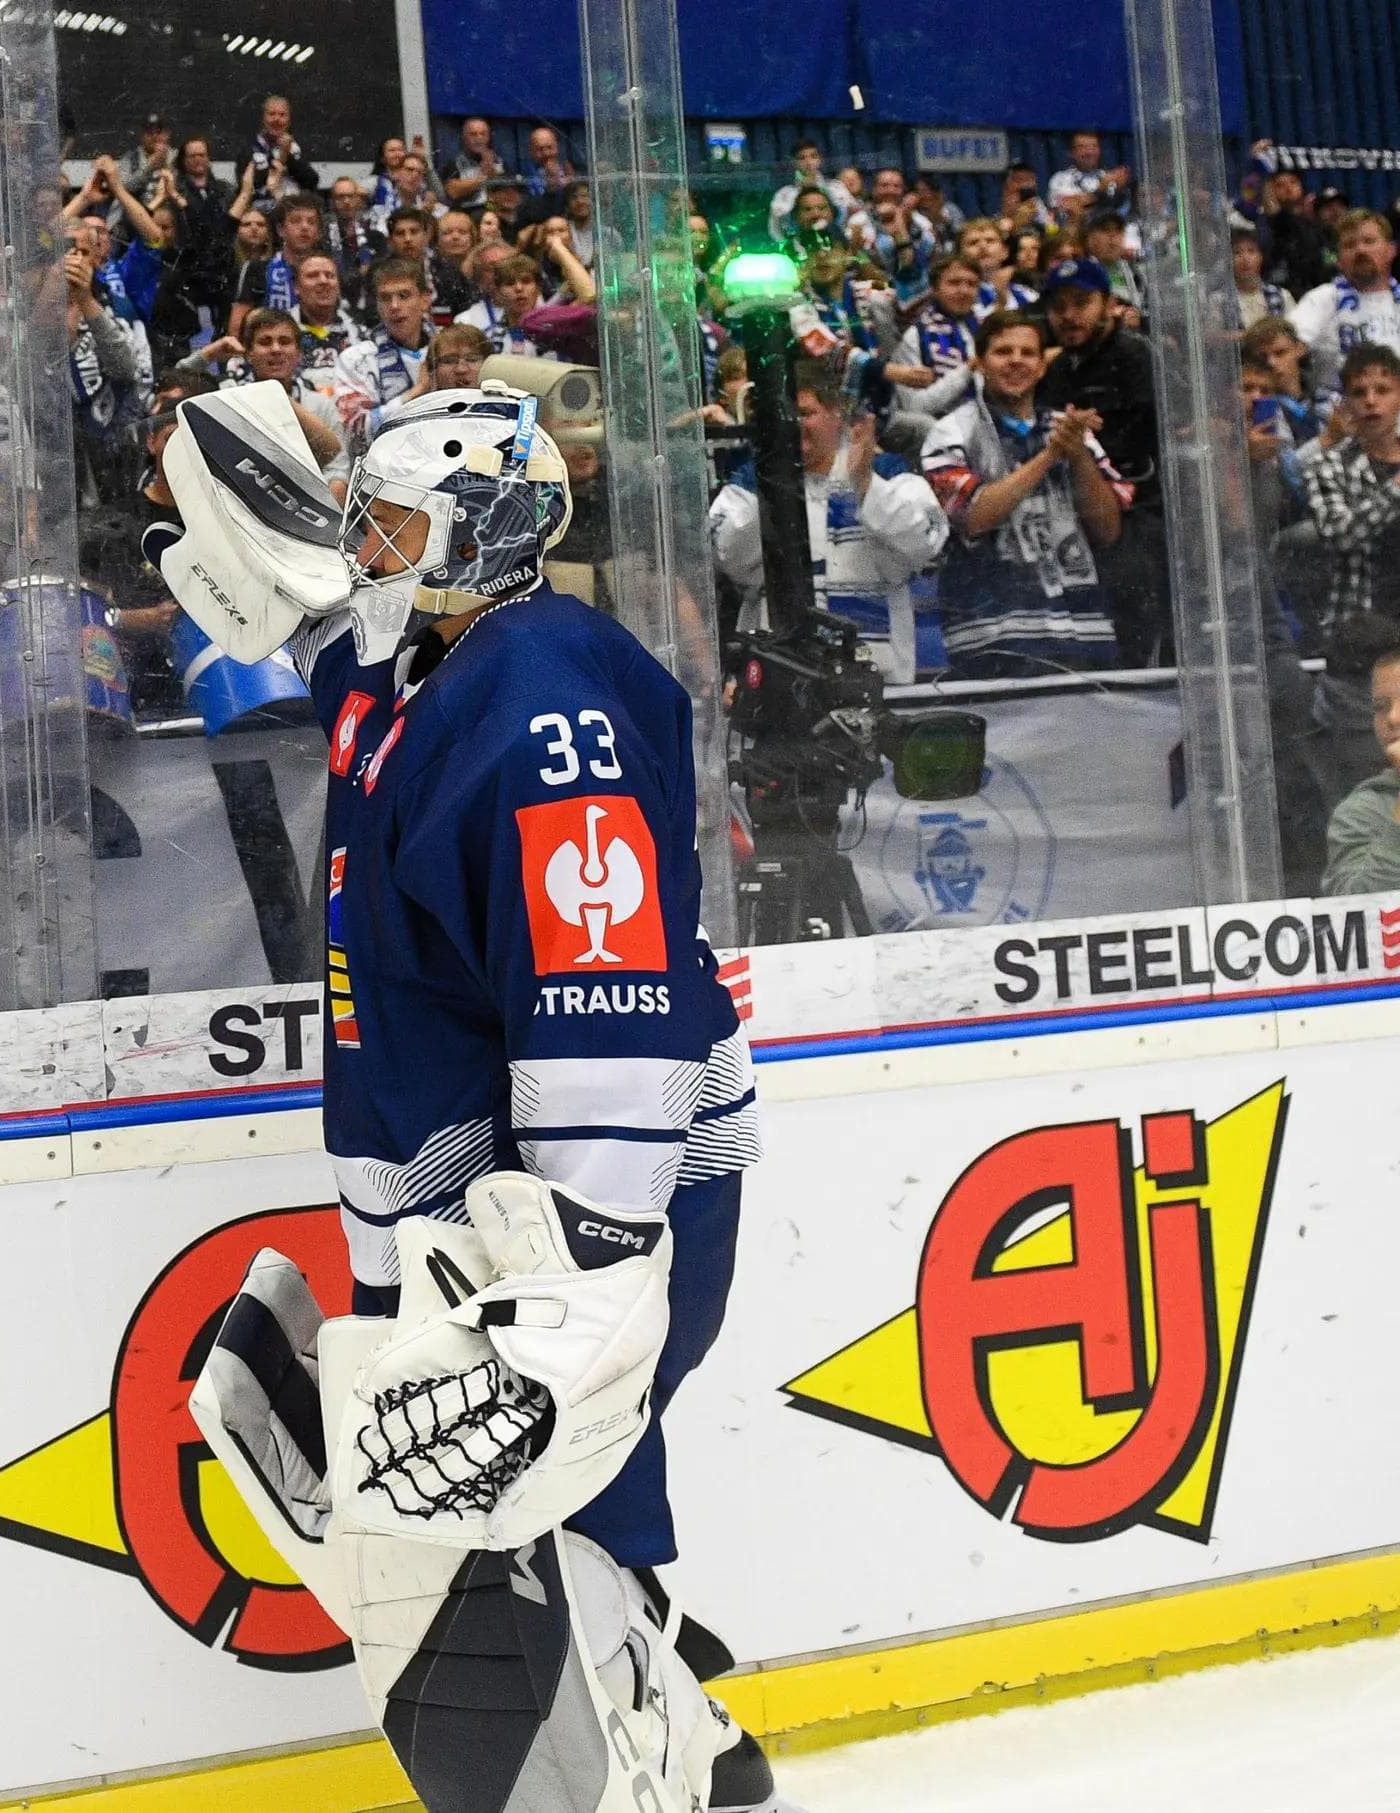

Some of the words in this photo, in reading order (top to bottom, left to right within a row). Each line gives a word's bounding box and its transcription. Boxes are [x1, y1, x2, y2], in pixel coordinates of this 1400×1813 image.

[235, 457, 329, 528] CCM
[480, 566, 535, 596] RIDERA
[529, 709, 623, 786] 33
[994, 910, 1368, 1003] STEELCOM
[534, 984, 670, 1016] TRAUSS
[209, 999, 320, 1077] ST
[577, 1220, 646, 1250] CCM
